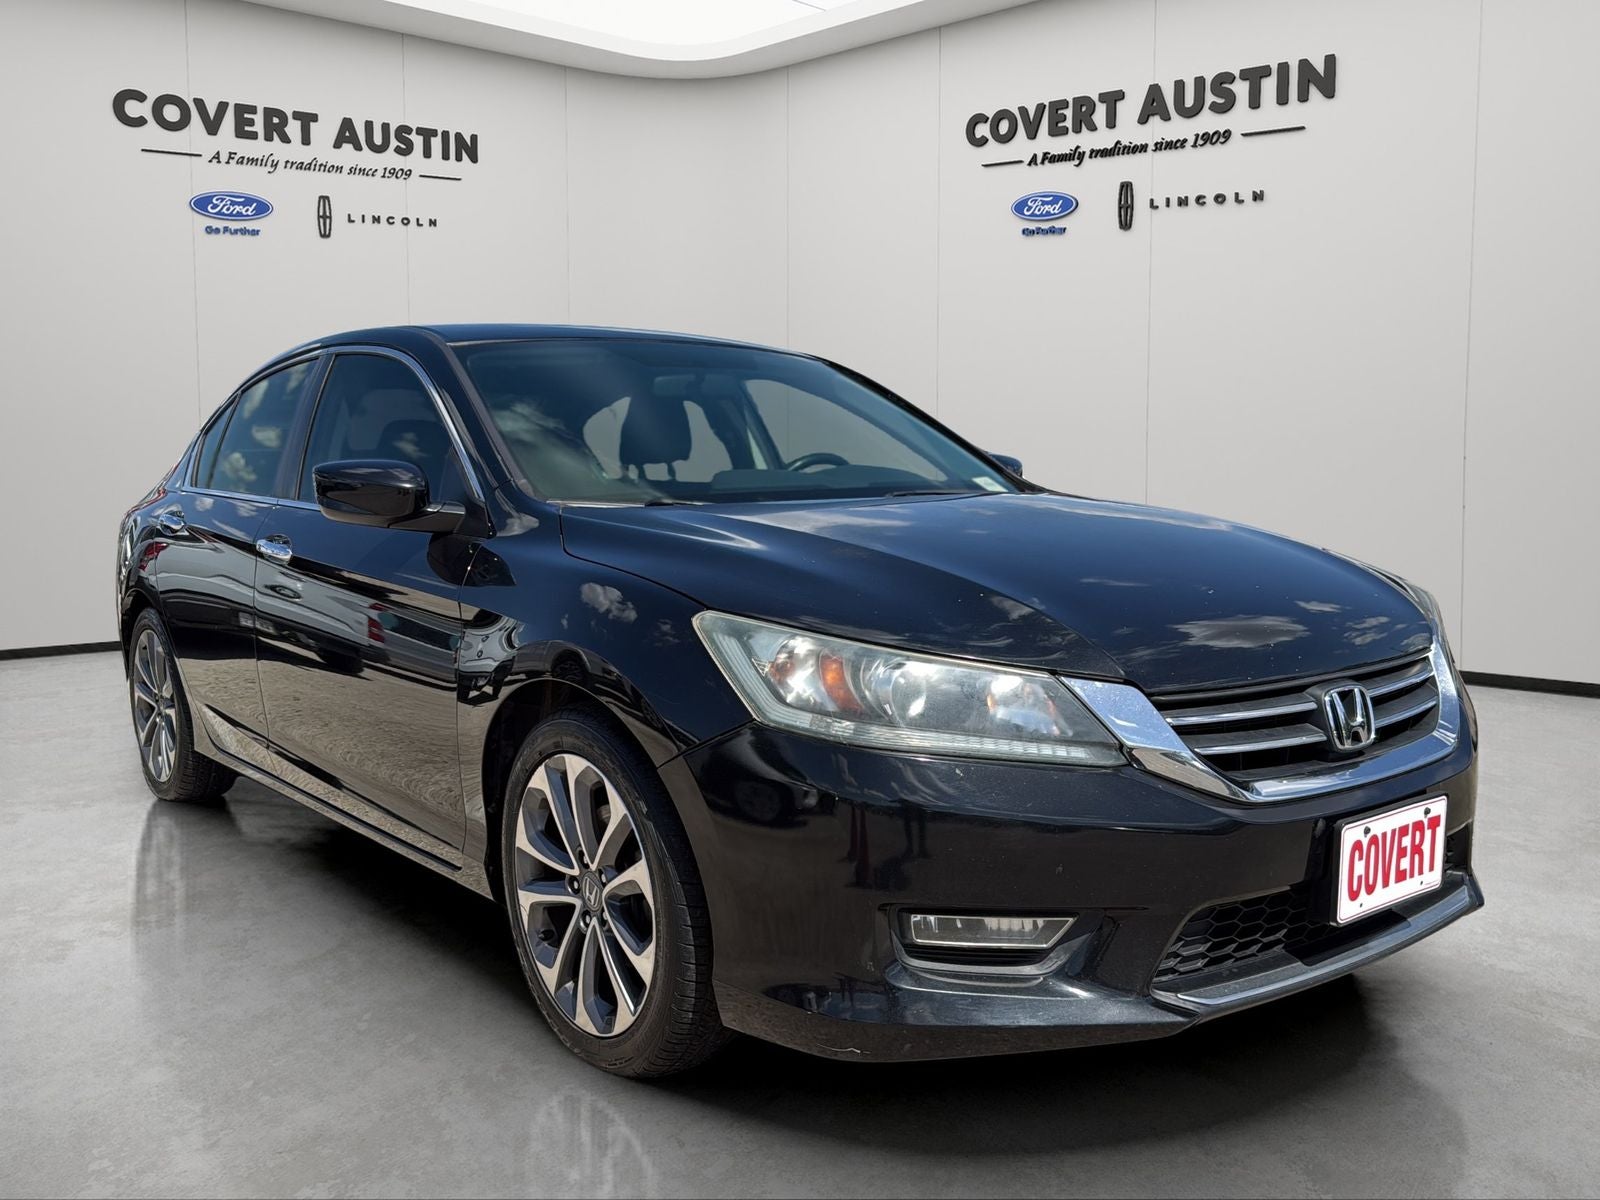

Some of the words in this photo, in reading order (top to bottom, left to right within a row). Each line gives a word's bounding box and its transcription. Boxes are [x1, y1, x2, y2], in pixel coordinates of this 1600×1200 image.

[966, 89, 1125, 147] COVERT
[1137, 53, 1337, 125] AUSTIN
[112, 88, 318, 146] COVERT
[333, 117, 479, 164] AUSTIN
[1027, 153, 1038, 167] A
[1040, 145, 1086, 167] Family
[1088, 140, 1149, 159] tradition
[1151, 137, 1188, 152] since
[1190, 128, 1232, 148] 1909
[208, 150, 222, 164] A
[225, 151, 279, 174] Family
[283, 157, 344, 174] tradition
[347, 164, 378, 178] since
[380, 167, 412, 180] 1909
[207, 195, 258, 216] Ford
[1023, 196, 1063, 216] Ford
[1150, 189, 1265, 210] LINCOLN
[205, 225, 221, 235] Go
[222, 226, 261, 237] Further
[347, 213, 438, 228] LINCOLN
[1347, 814, 1441, 902] COVERT
